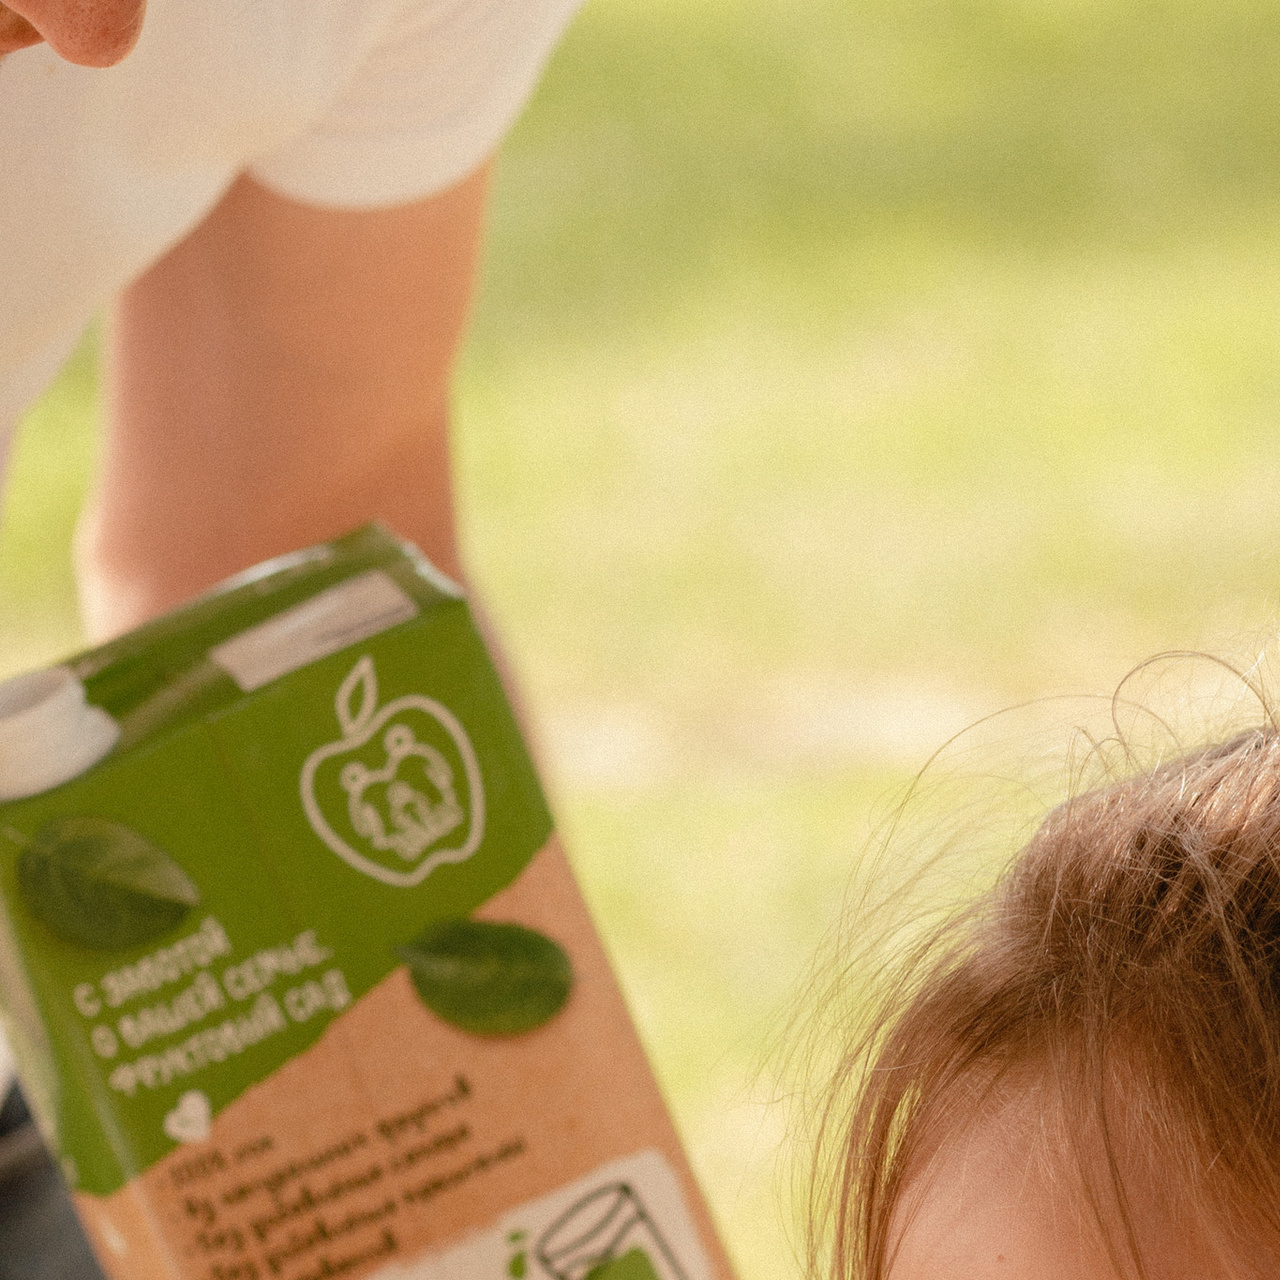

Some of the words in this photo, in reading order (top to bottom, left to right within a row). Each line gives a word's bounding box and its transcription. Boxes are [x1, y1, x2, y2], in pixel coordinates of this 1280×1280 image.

[108, 993, 285, 1095] ФРУКТОВЫЙ
[284, 969, 352, 1023] САД
[117, 971, 224, 1048] ВАШЕЙ
